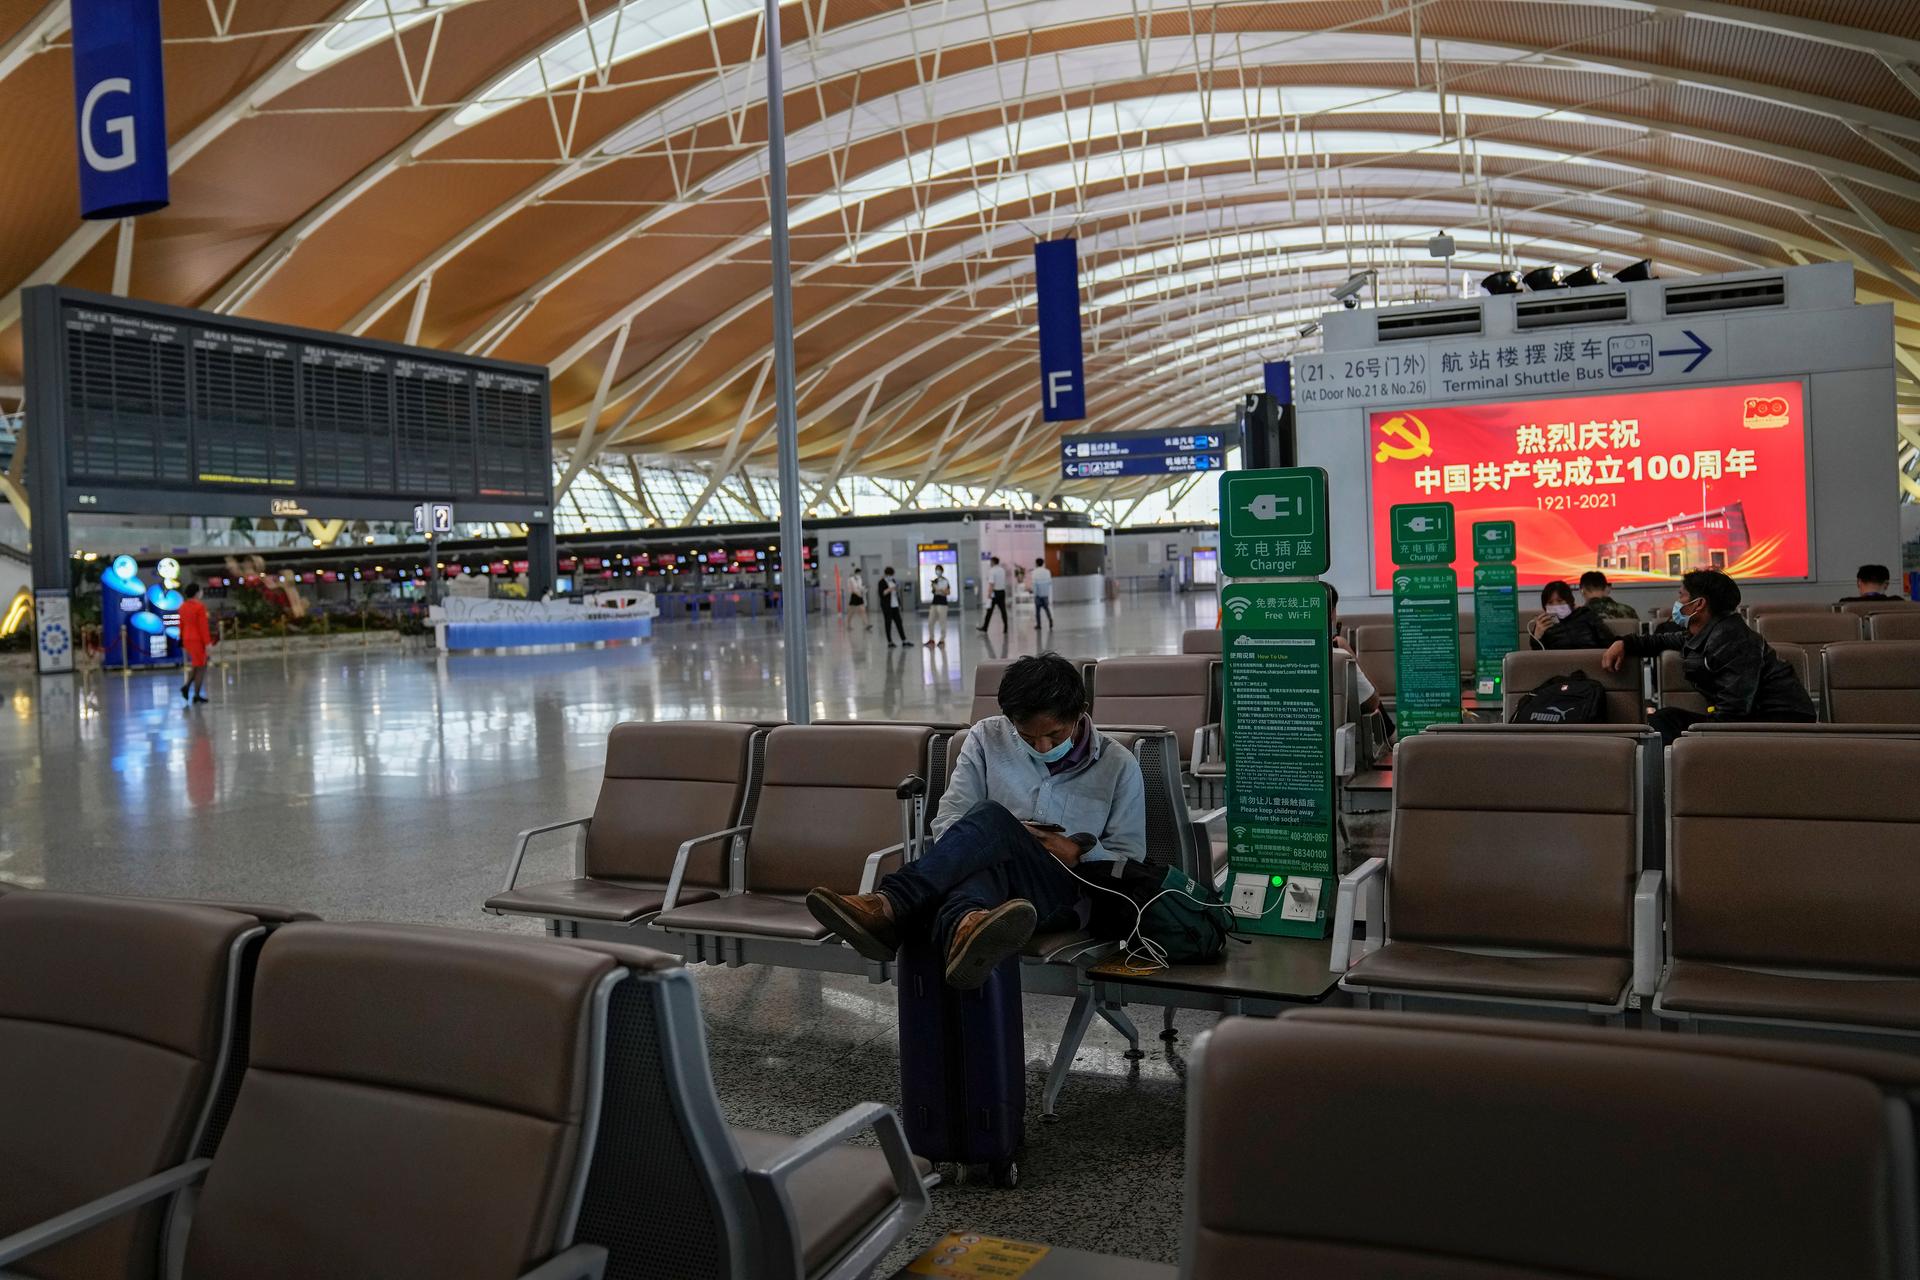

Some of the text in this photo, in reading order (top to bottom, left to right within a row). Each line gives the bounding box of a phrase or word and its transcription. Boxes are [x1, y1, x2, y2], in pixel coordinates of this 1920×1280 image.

[81, 77, 136, 172] G
[1442, 338, 1603, 373] 航站楼摆渡车
[1442, 366, 1604, 392] Terminal Shuttle Bus
[1049, 370, 1073, 408] F
[1302, 380, 1426, 403] (At Door No.21 & No.26)
[1516, 419, 1641, 454] 热烈庆祝
[1415, 447, 1757, 495] 中国共产党成立100周年
[1537, 493, 1617, 510] 1921-2021
[1234, 540, 1312, 557] 充电插座
[1400, 543, 1448, 553] 充电插座
[1250, 558, 1296, 573] Charger
[1409, 554, 1438, 562] Charger
[1256, 597, 1320, 609] 免费无线上网
[1265, 611, 1311, 620] Free Wi-Fi
[1530, 712, 1560, 722] PUMA
[1240, 796, 1315, 807] 请勿让儿童接触插座
[1274, 807, 1297, 815] children
[1299, 809, 1314, 817] away
[1293, 848, 1327, 859] 68340100
